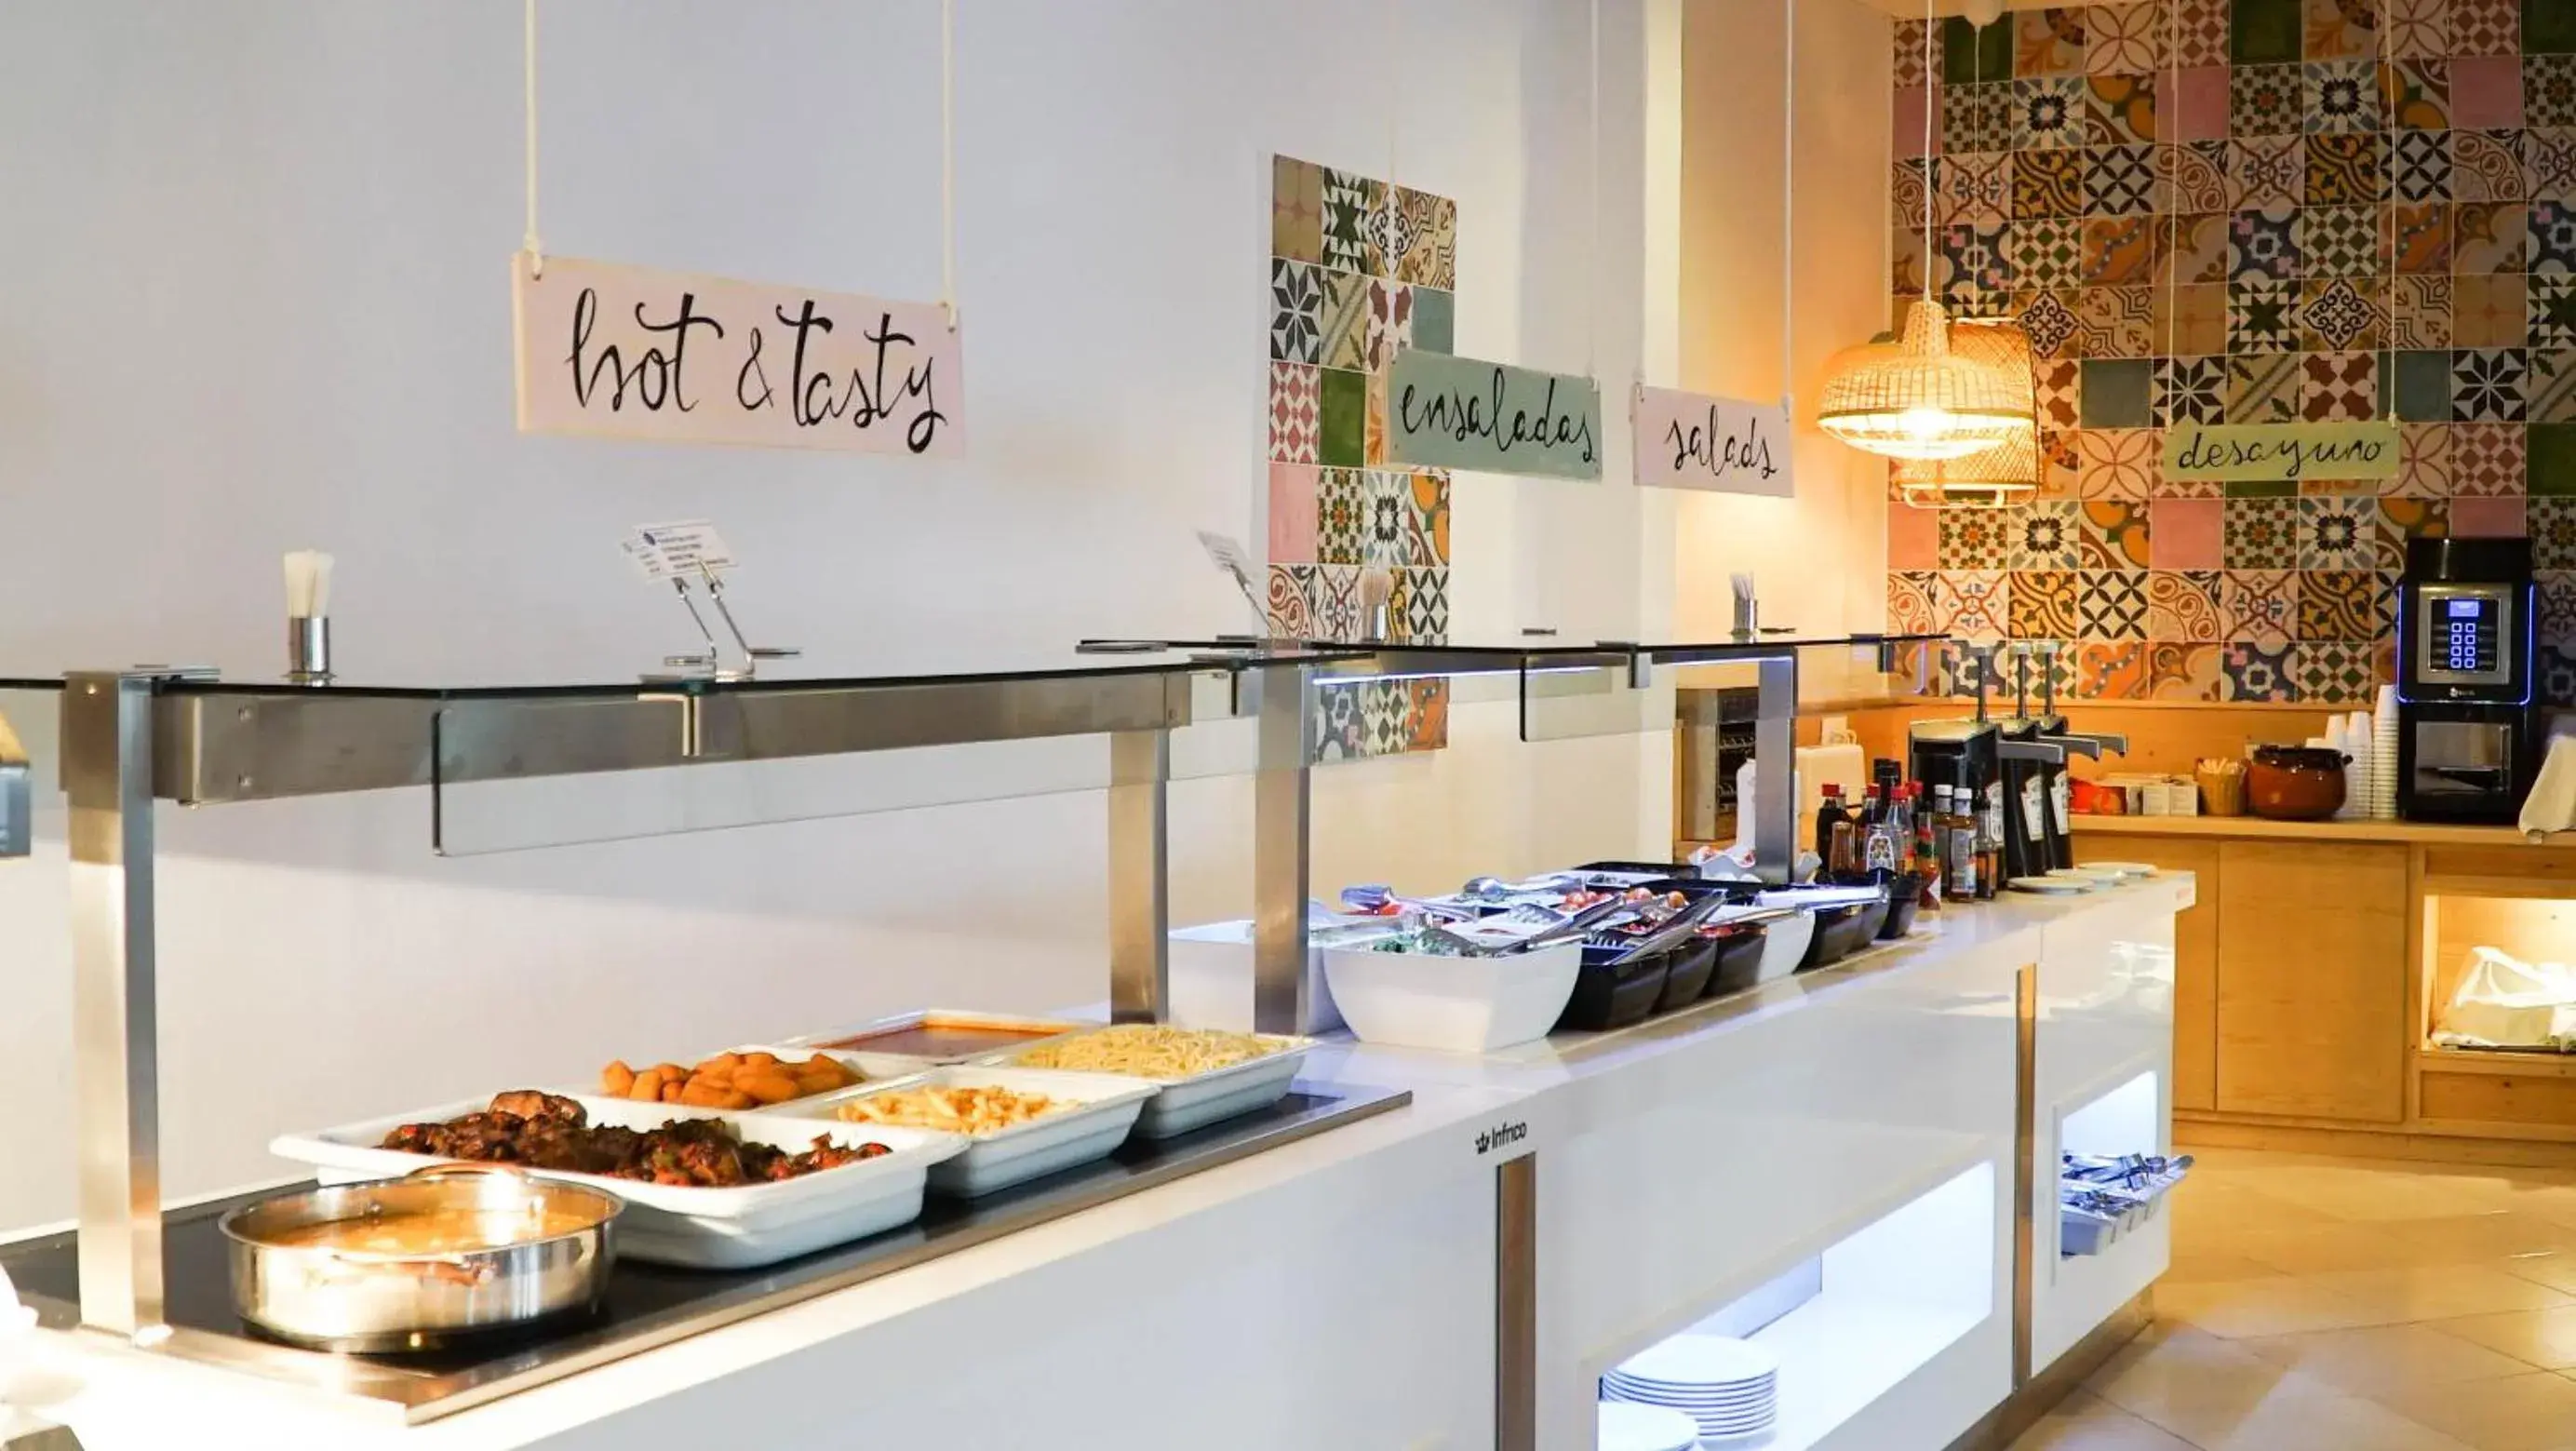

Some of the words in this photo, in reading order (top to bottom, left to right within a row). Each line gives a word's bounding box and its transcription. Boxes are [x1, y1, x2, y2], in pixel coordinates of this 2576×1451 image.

[565, 288, 725, 412] hot
[736, 327, 774, 411] &
[775, 300, 948, 454] tasty
[1400, 368, 1598, 463] ensaladas
[1663, 404, 1778, 480] salads
[2178, 432, 2385, 477] desayuno
